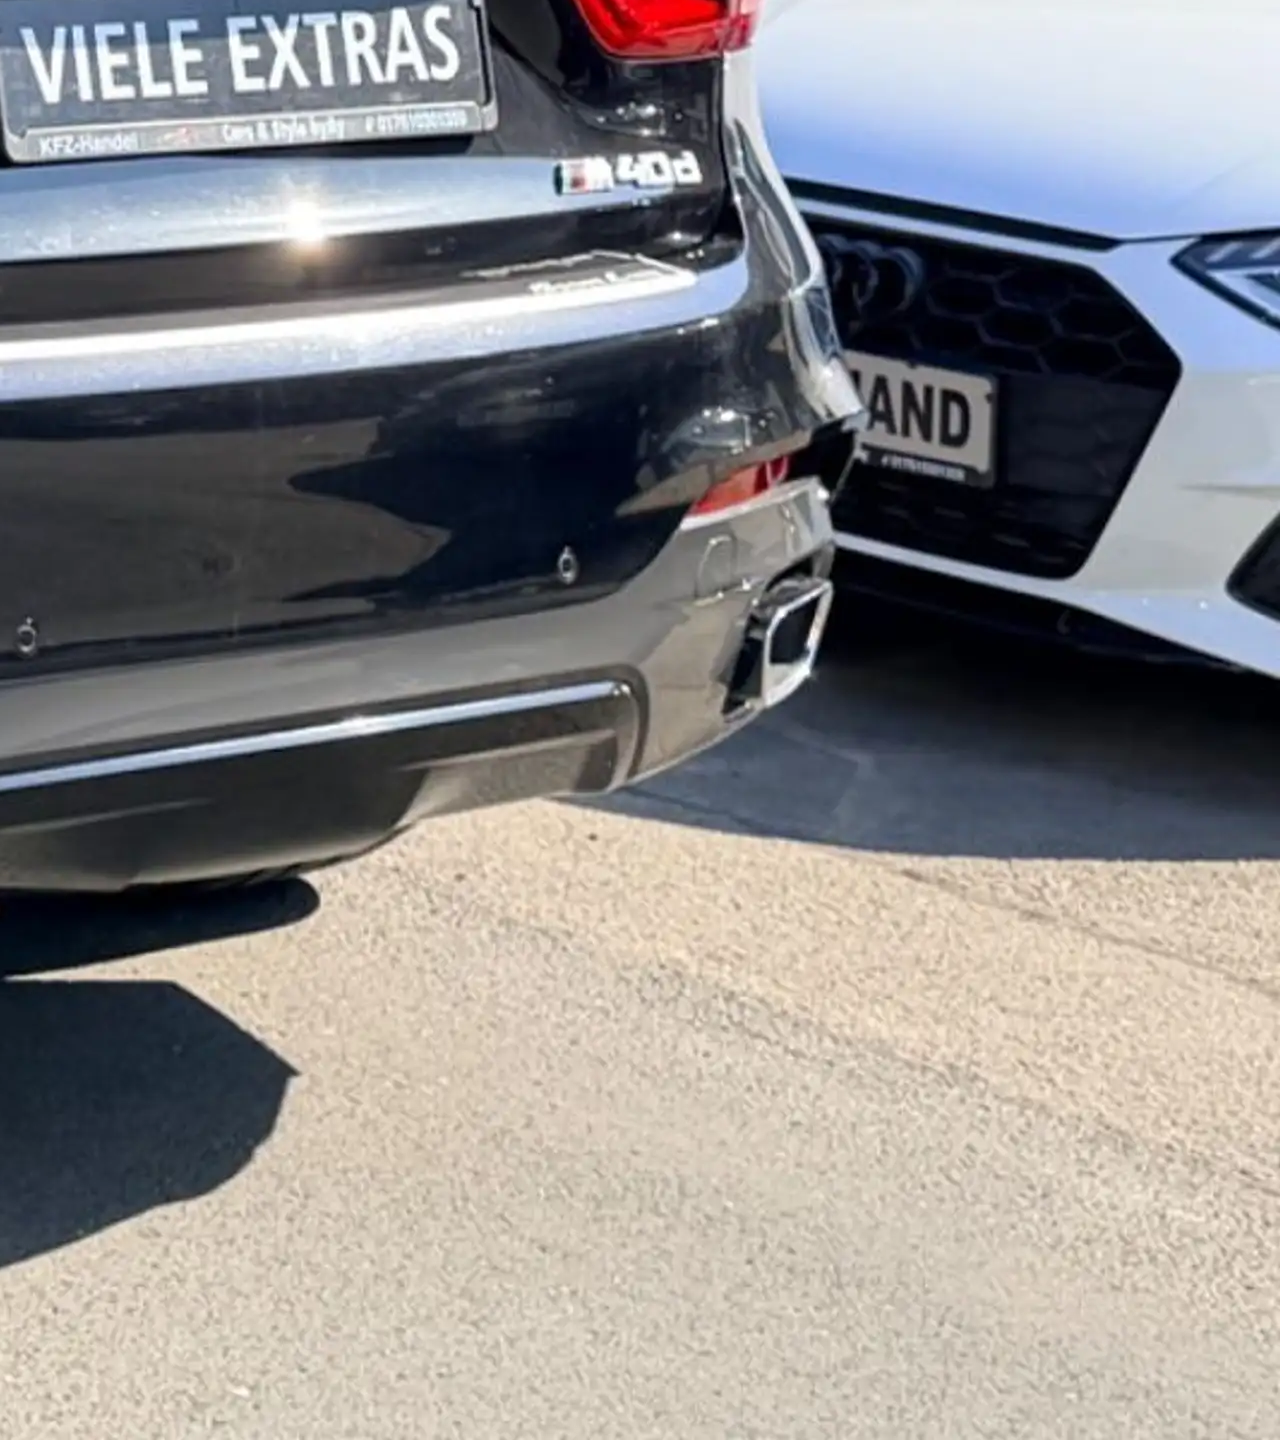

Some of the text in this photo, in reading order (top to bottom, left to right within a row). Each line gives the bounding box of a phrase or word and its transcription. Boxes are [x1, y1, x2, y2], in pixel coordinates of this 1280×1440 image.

[19, 4, 462, 104] VIELE EXTRAS
[38, 131, 140, 157] KFZ-Handel
